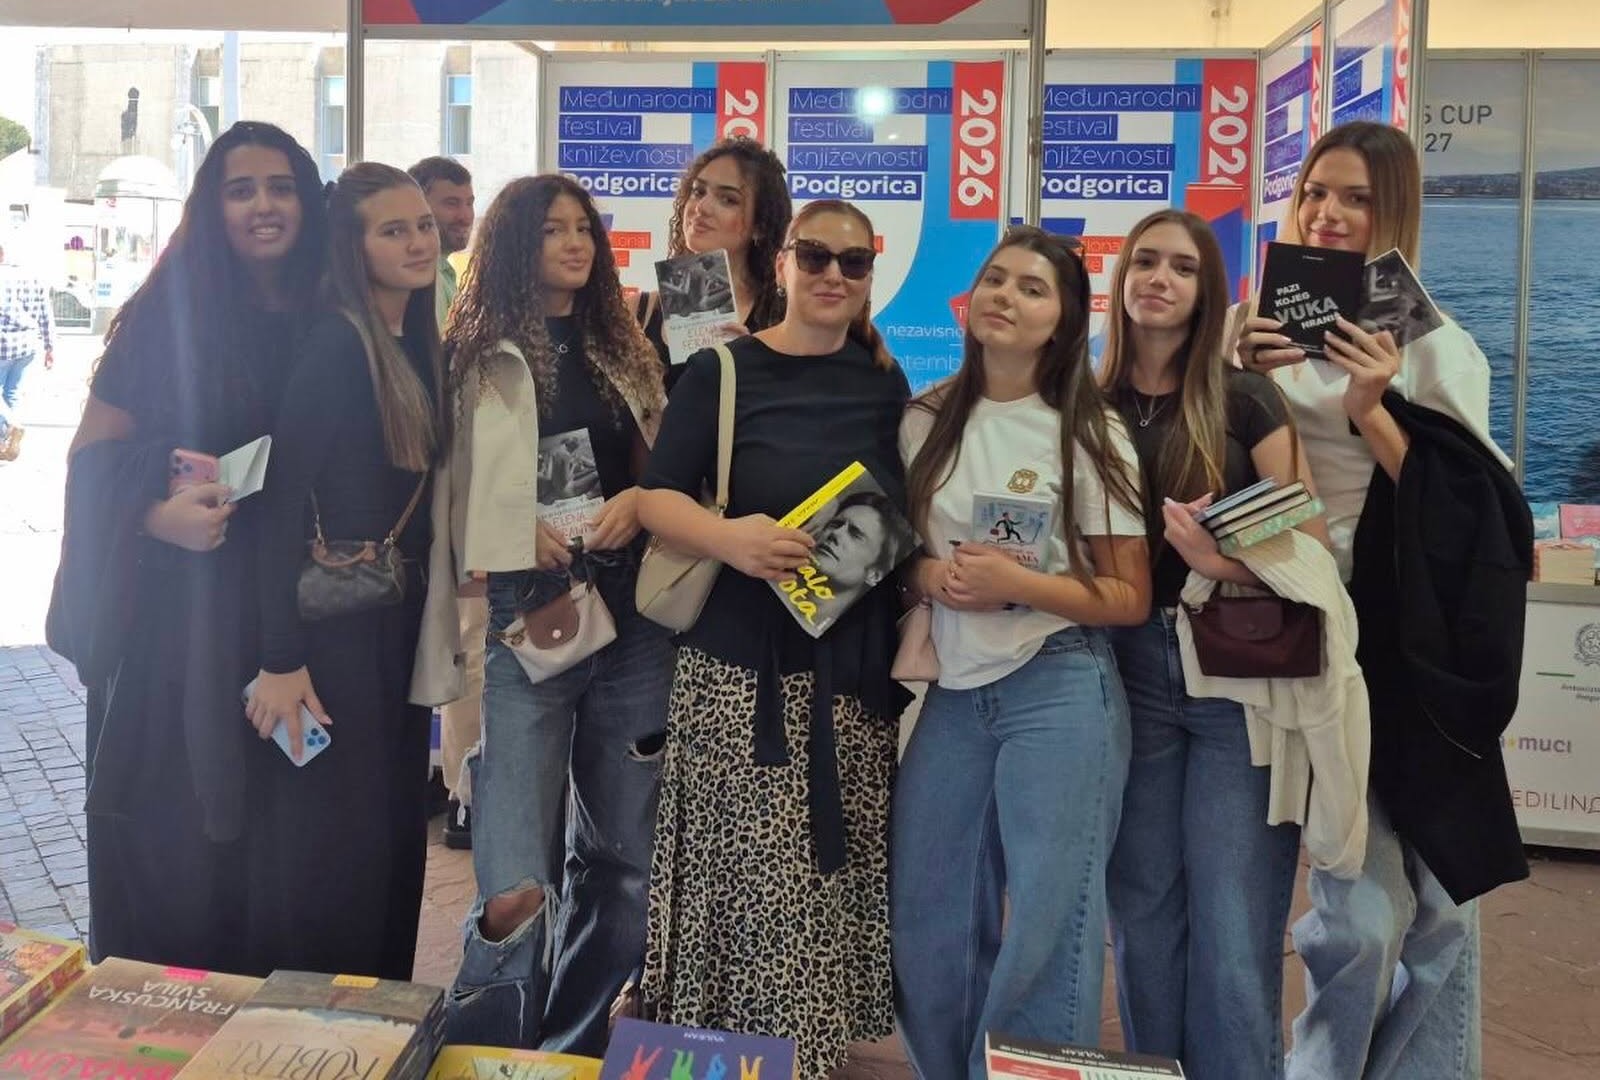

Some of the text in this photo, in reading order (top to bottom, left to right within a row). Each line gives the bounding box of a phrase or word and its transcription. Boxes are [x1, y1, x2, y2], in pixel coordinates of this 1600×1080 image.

[564, 89, 712, 109] Međunarodni
[793, 89, 948, 109] Međuodni
[564, 115, 637, 136] festival
[723, 89, 759, 140] 20
[1441, 104, 1493, 125] CUP
[793, 118, 870, 138] festival
[1043, 116, 1113, 136] estival
[1208, 85, 1249, 185] 202
[563, 144, 689, 166] književnosti
[791, 147, 923, 170] književnosti
[957, 89, 997, 206] 2026
[1045, 146, 1170, 169] njiževnosti
[791, 175, 917, 198] Podgorica
[1274, 291, 1311, 308] KOJEG
[1277, 283, 1300, 296] PAZI
[1273, 296, 1340, 326] VUKA
[797, 557, 836, 600] alo
[88, 984, 236, 1018] FRANCUSKA
[143, 980, 212, 1000] SVILA
